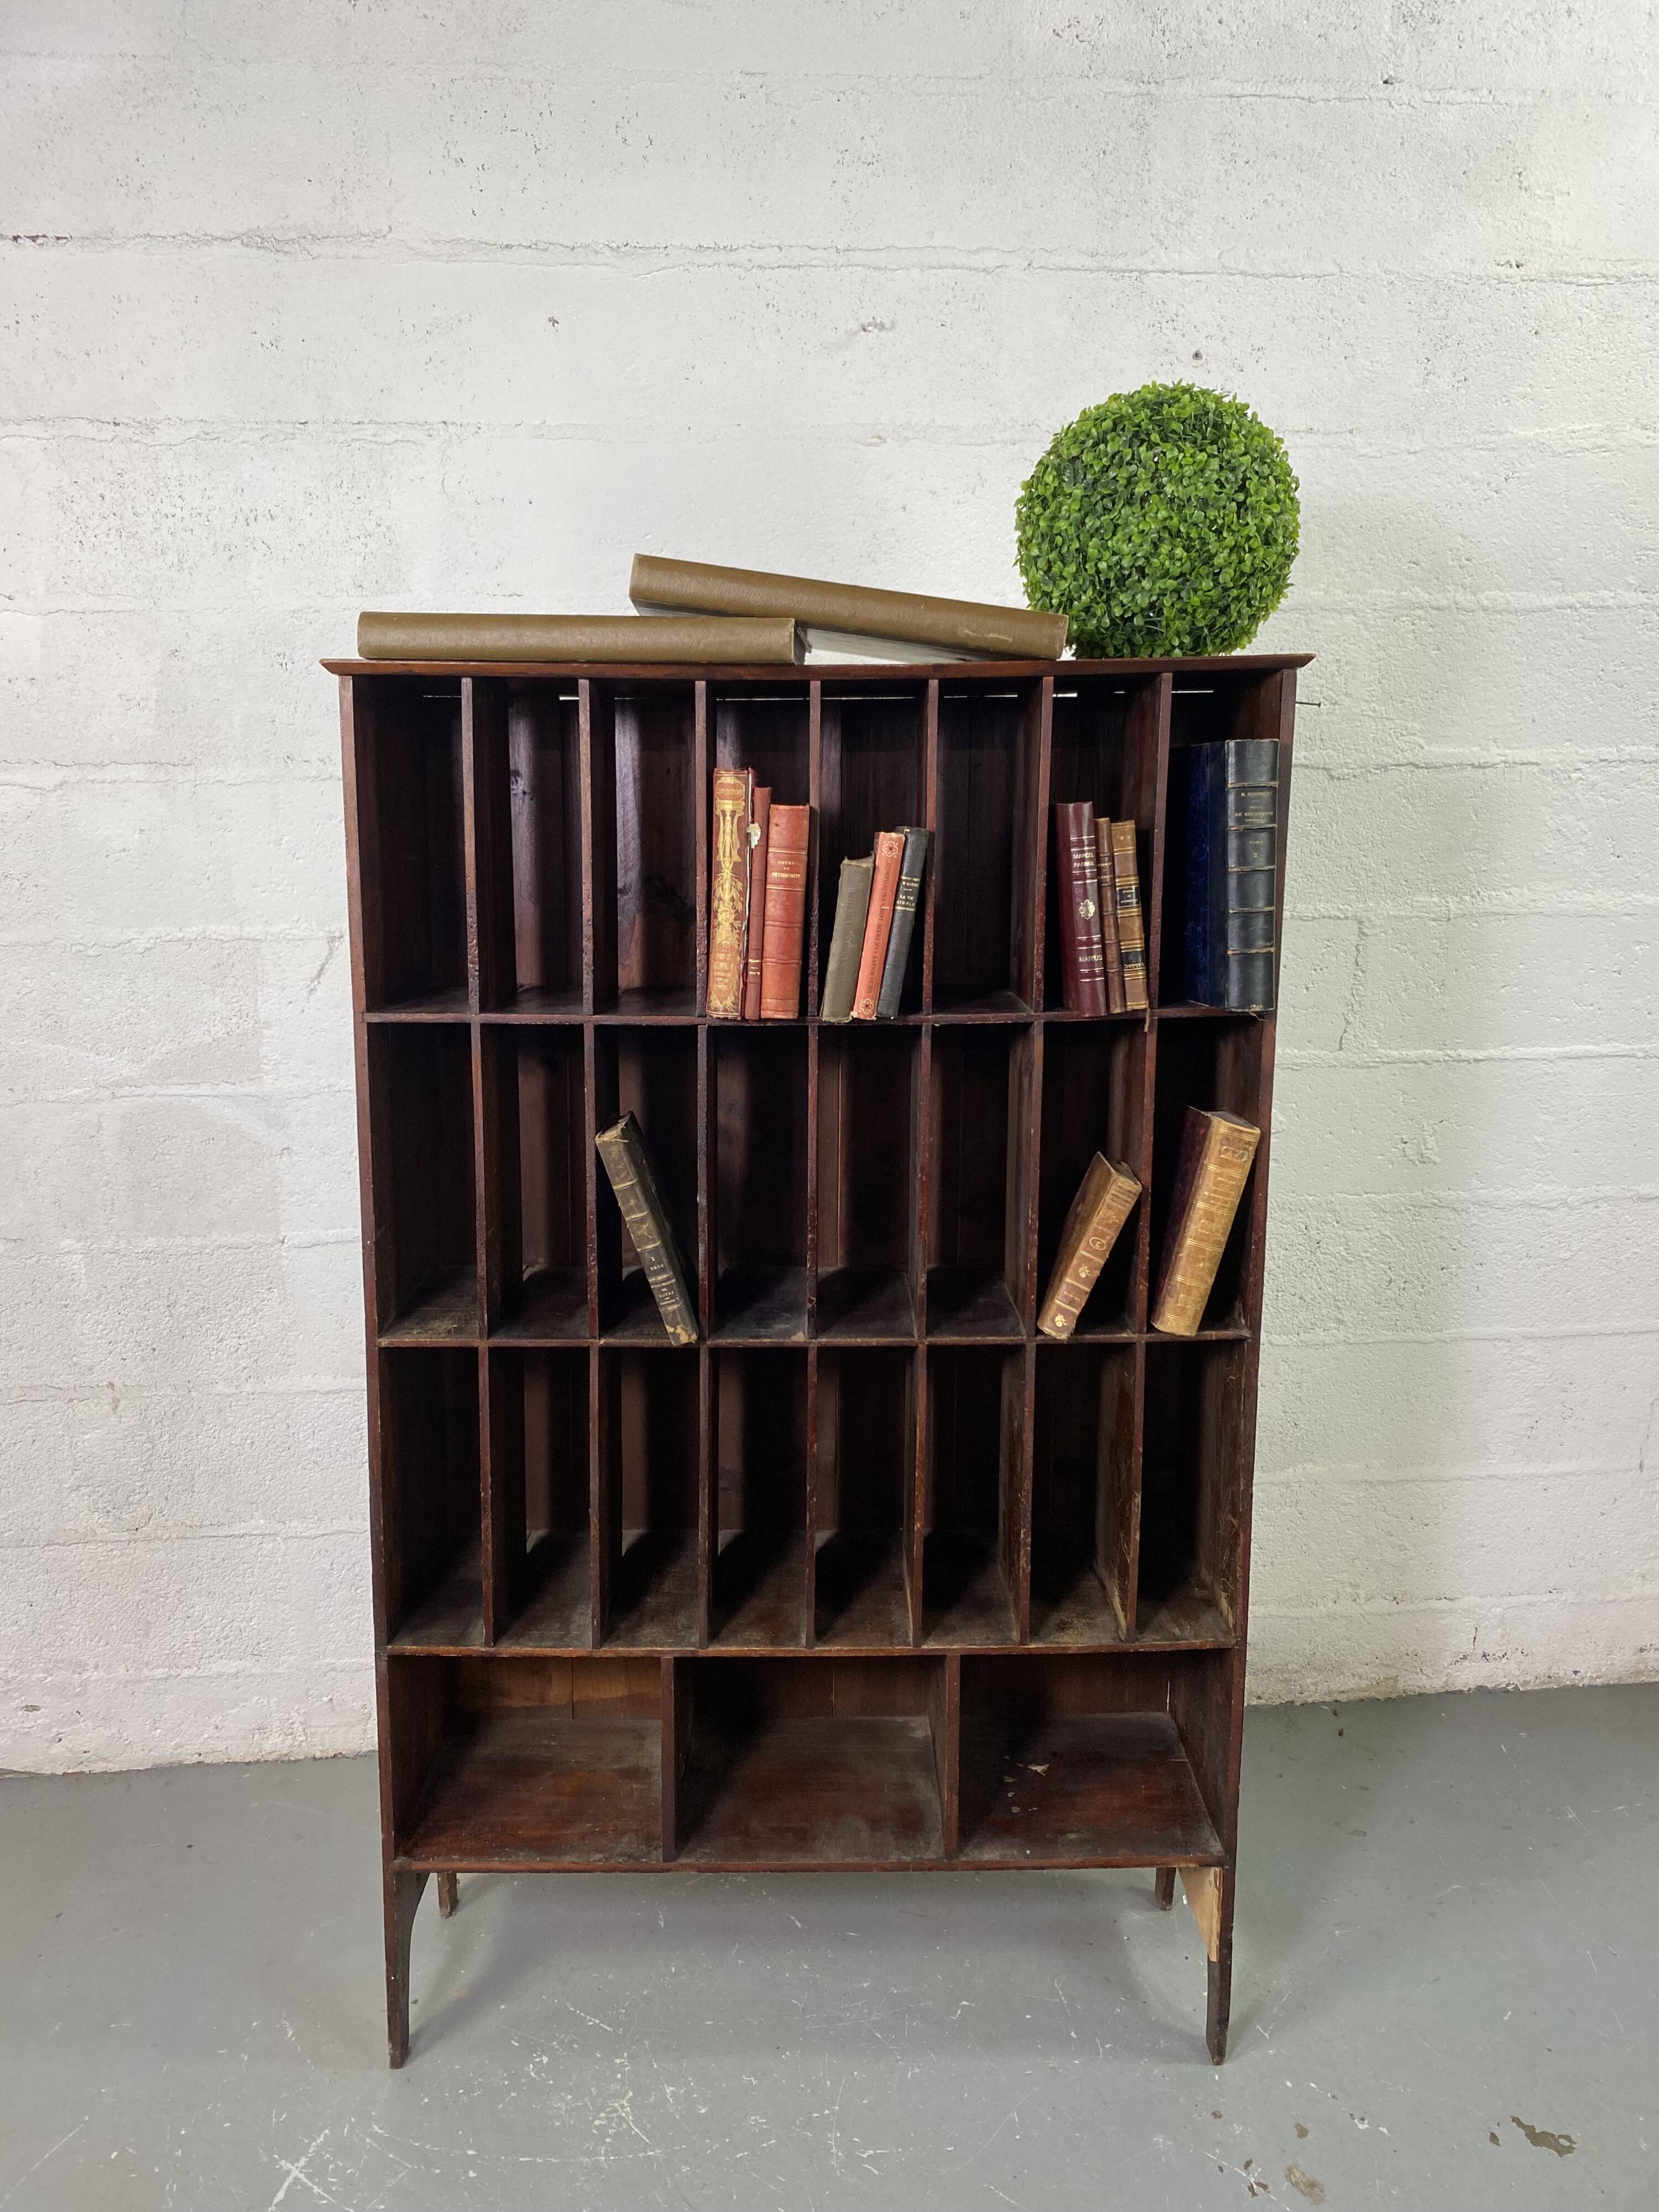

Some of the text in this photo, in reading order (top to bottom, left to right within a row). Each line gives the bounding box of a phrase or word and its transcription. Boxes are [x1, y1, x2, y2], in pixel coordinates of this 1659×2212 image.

[874, 940, 880, 950] LE
[881, 863, 891, 902] FAUNTLEROY
[1078, 954, 1103, 963] MARIUS
